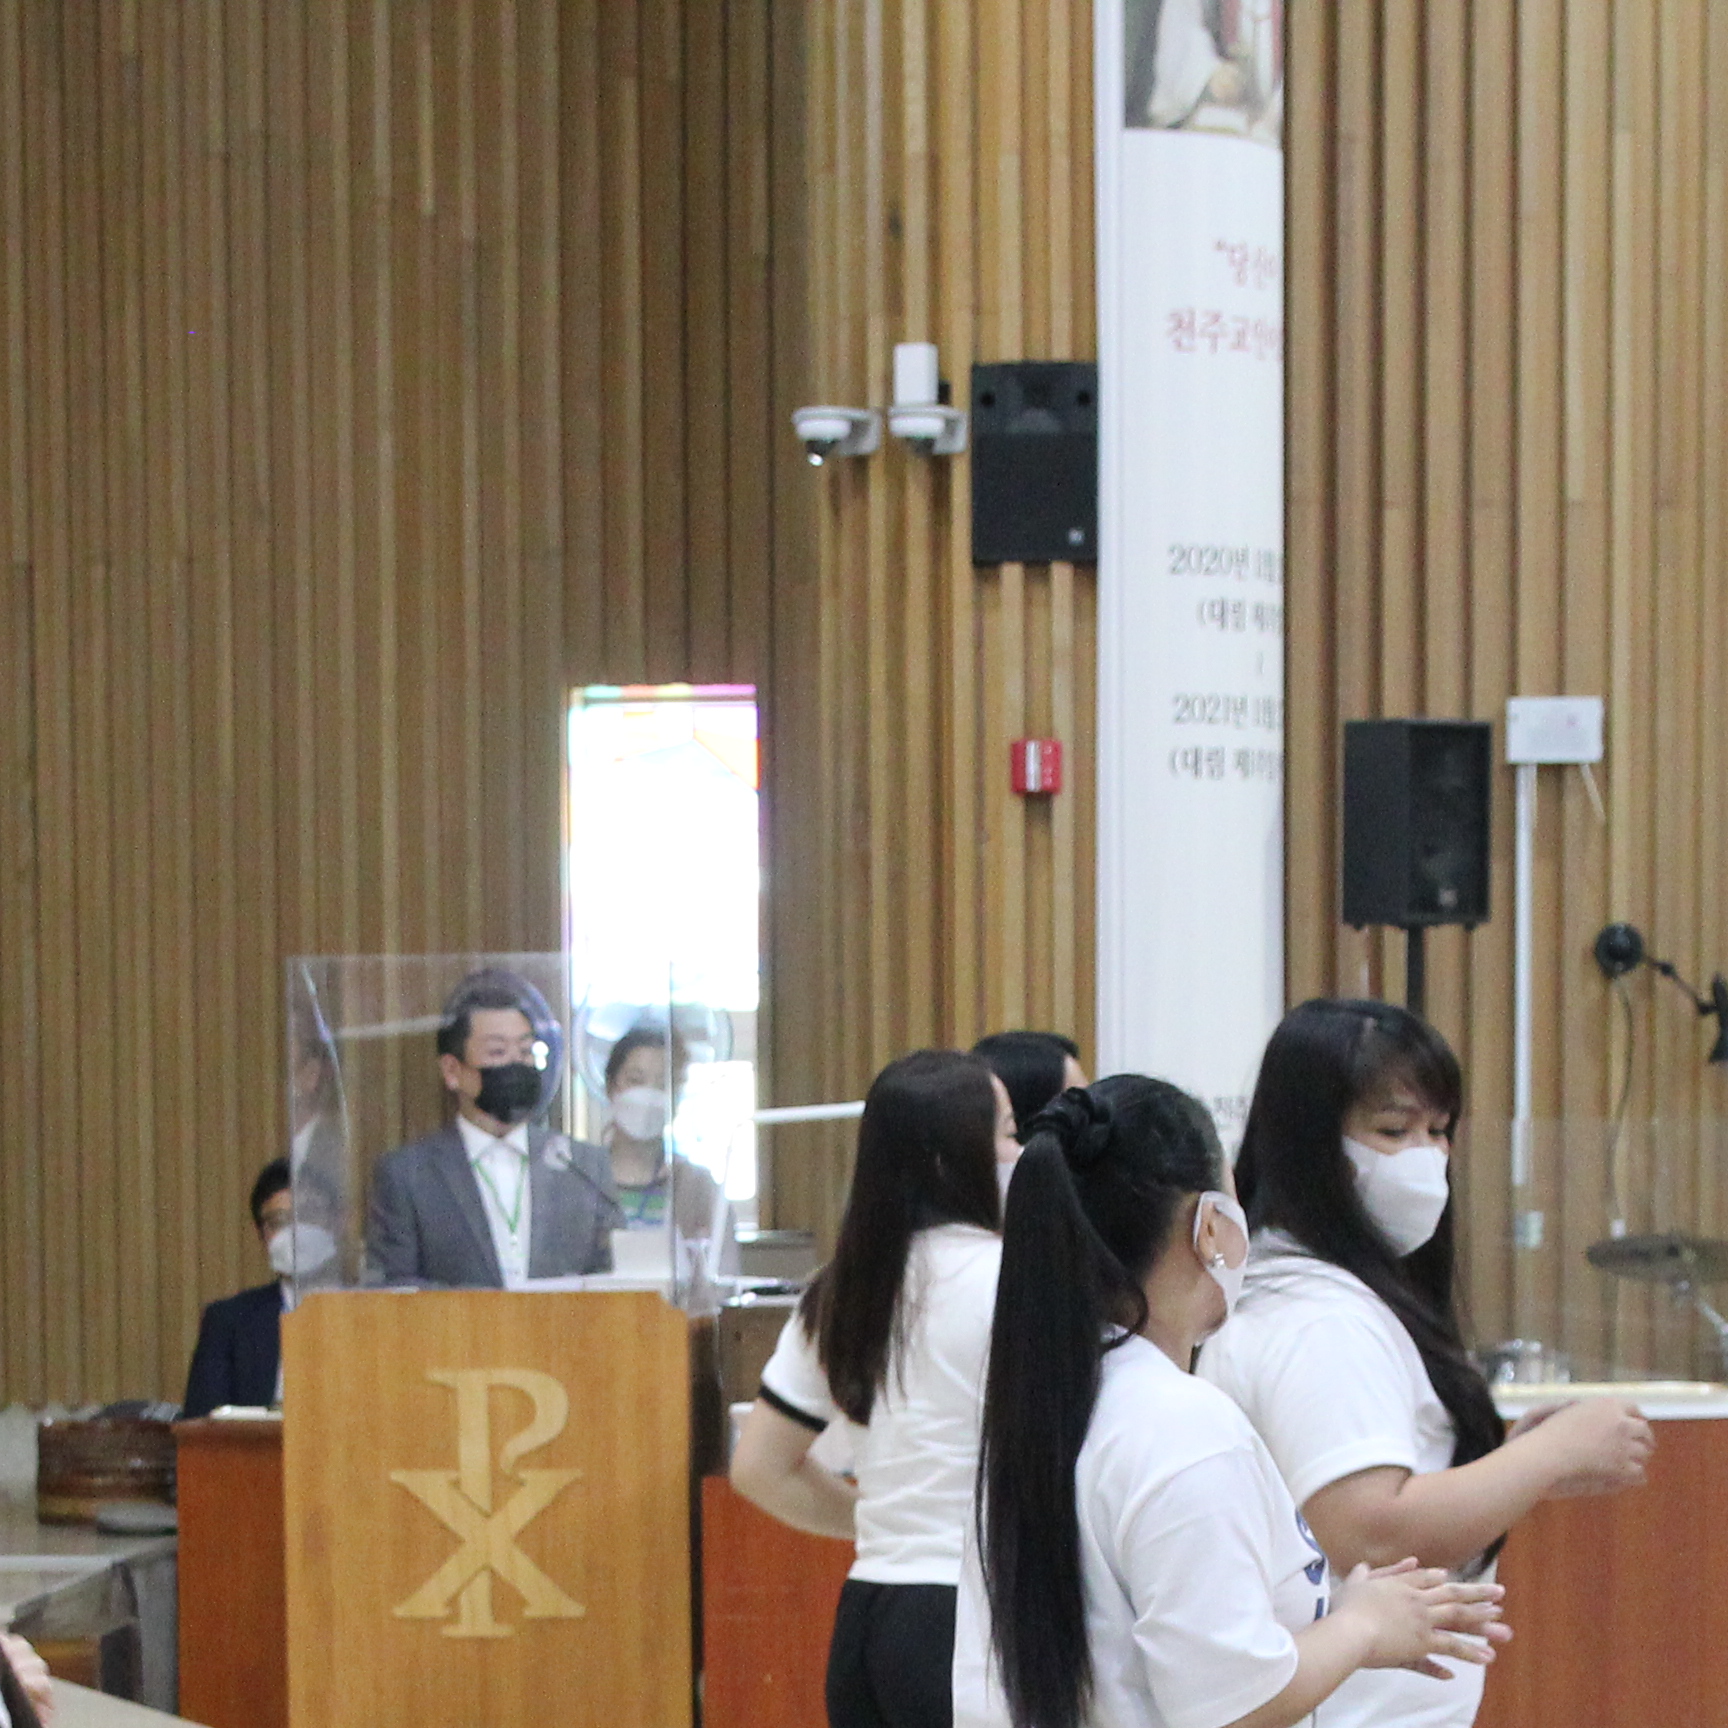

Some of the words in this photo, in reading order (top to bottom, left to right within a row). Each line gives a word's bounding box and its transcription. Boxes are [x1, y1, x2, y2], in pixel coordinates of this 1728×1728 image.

[1168, 545, 1250, 582] 2020년
[1196, 598, 1246, 631] (대림
[1173, 692, 1249, 730] 2021년
[1168, 746, 1226, 780] (대림
